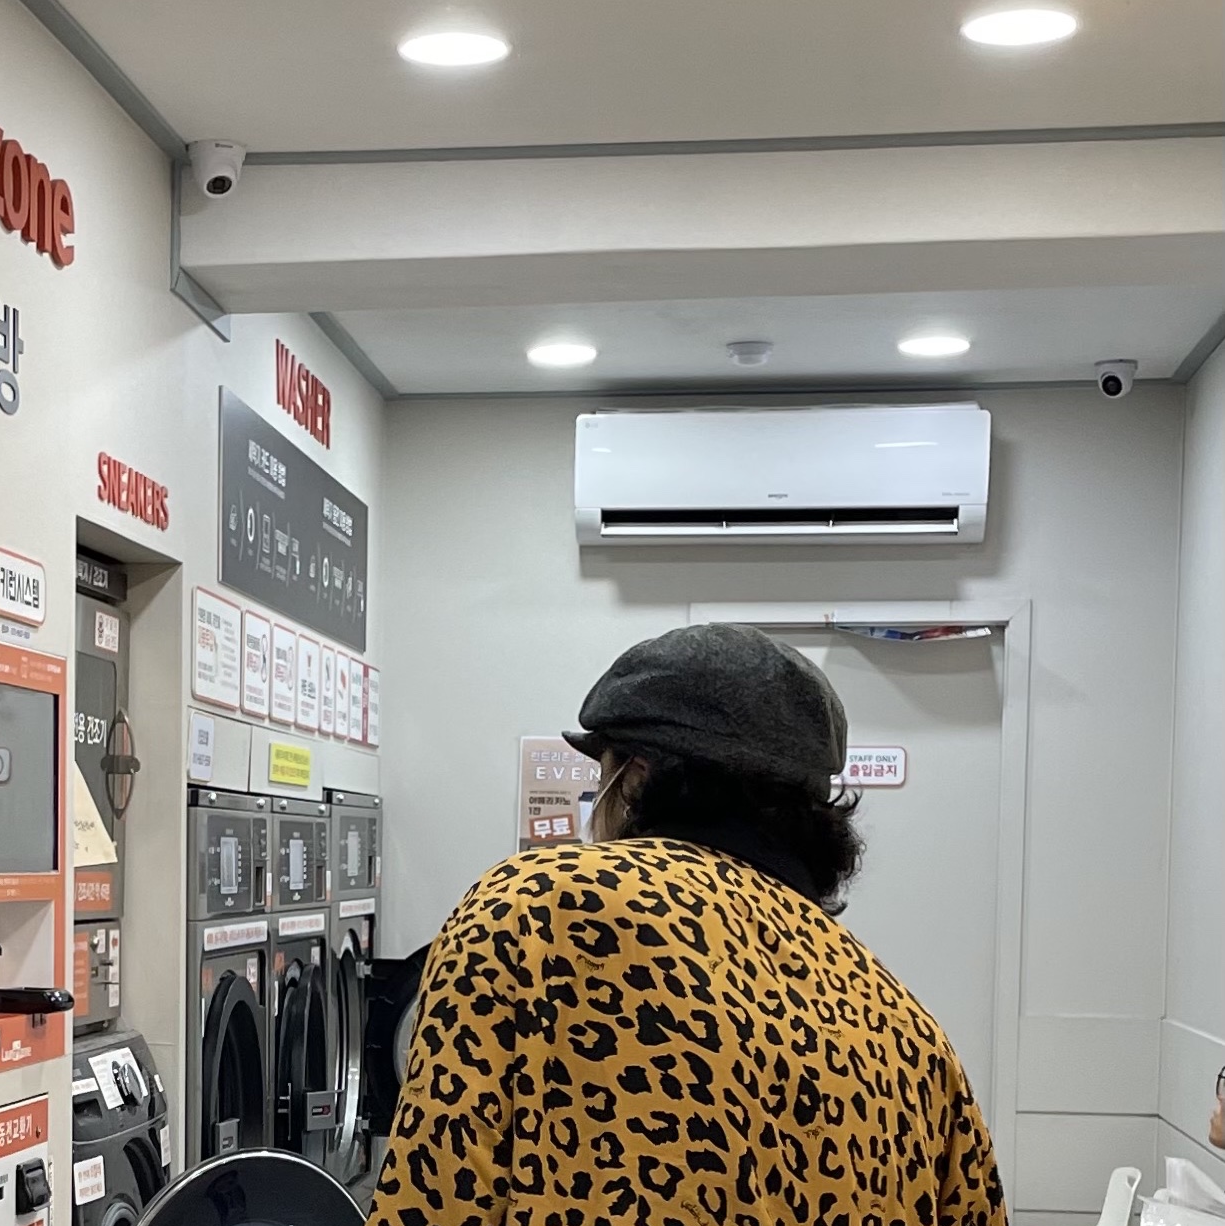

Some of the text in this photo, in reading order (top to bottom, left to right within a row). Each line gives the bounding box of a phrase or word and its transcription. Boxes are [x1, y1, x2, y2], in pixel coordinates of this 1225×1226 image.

[276, 338, 331, 451] WASHER
[97, 451, 169, 532] SNEAKERS
[87, 716, 107, 749] 건조기
[849, 755, 898, 763] STAFF ONLY
[849, 764, 898, 777] 출입금지
[534, 817, 571, 839] 무료
